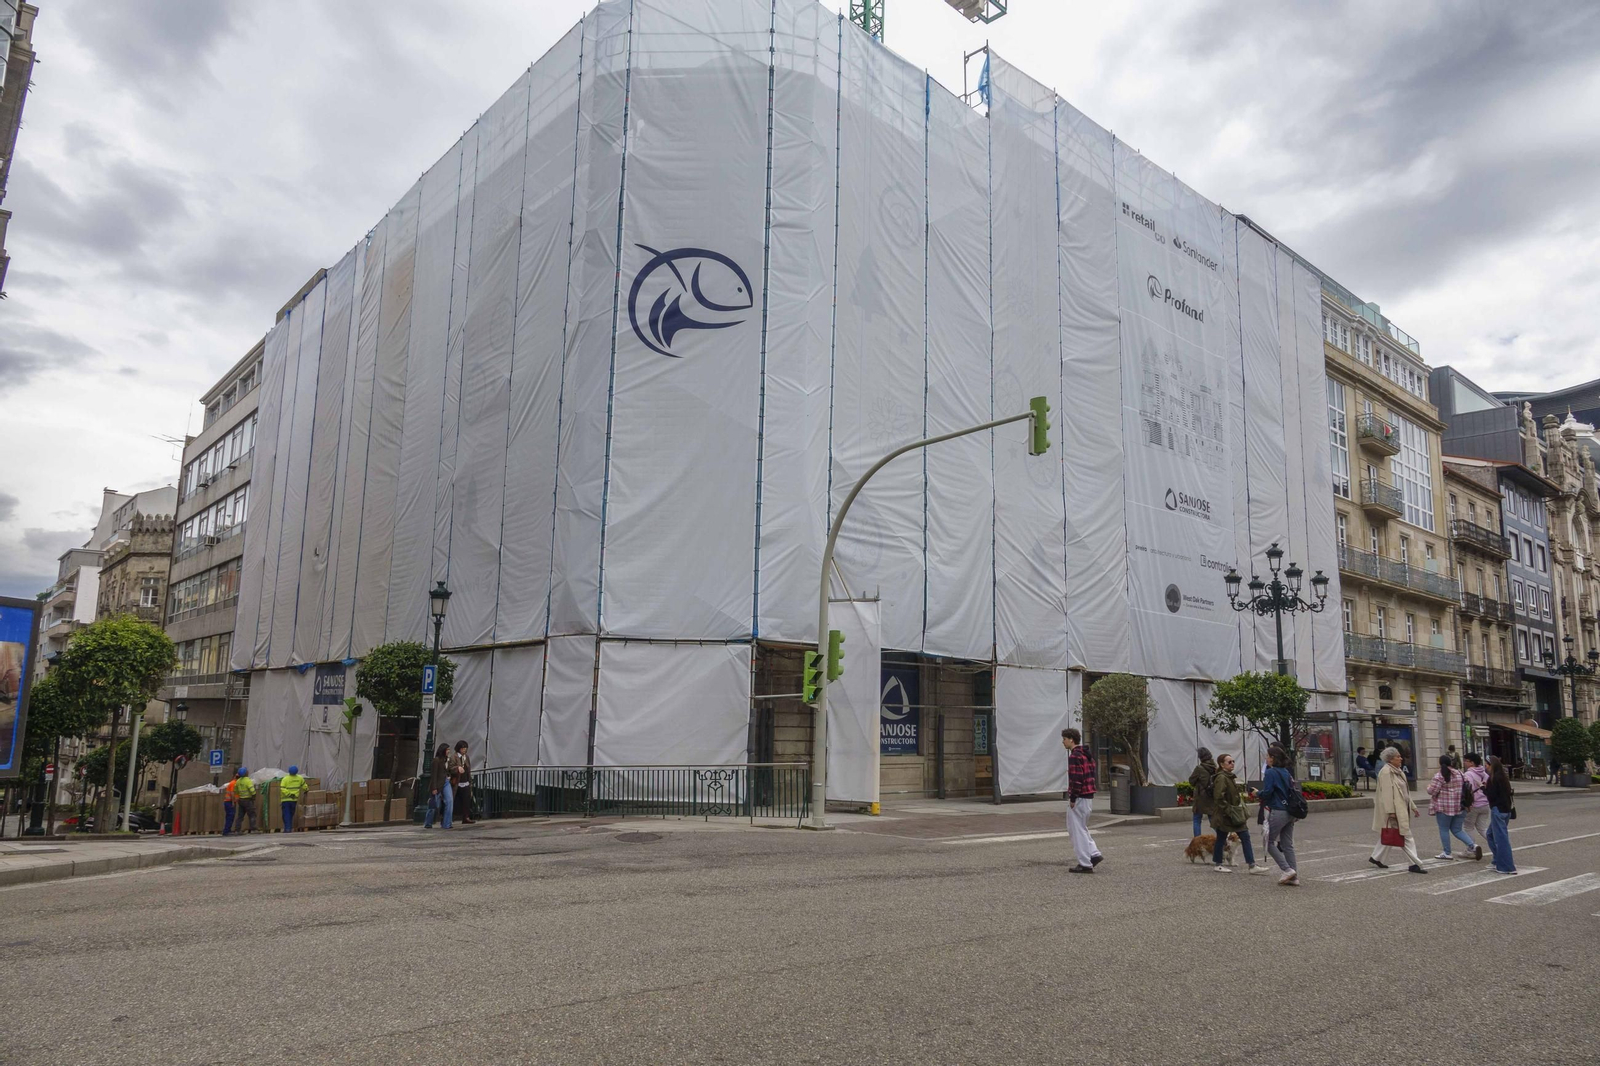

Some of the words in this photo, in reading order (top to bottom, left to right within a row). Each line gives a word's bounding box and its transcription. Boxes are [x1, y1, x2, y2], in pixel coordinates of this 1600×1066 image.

[1131, 211, 1155, 231] retail
[1155, 232, 1166, 244] co
[1183, 241, 1218, 271] Santander
[1165, 289, 1204, 323] Profand
[1179, 492, 1211, 513] SANJOSE
[425, 669, 432, 689] P
[880, 724, 916, 736] ANJOSE
[213, 752, 220, 764] P
